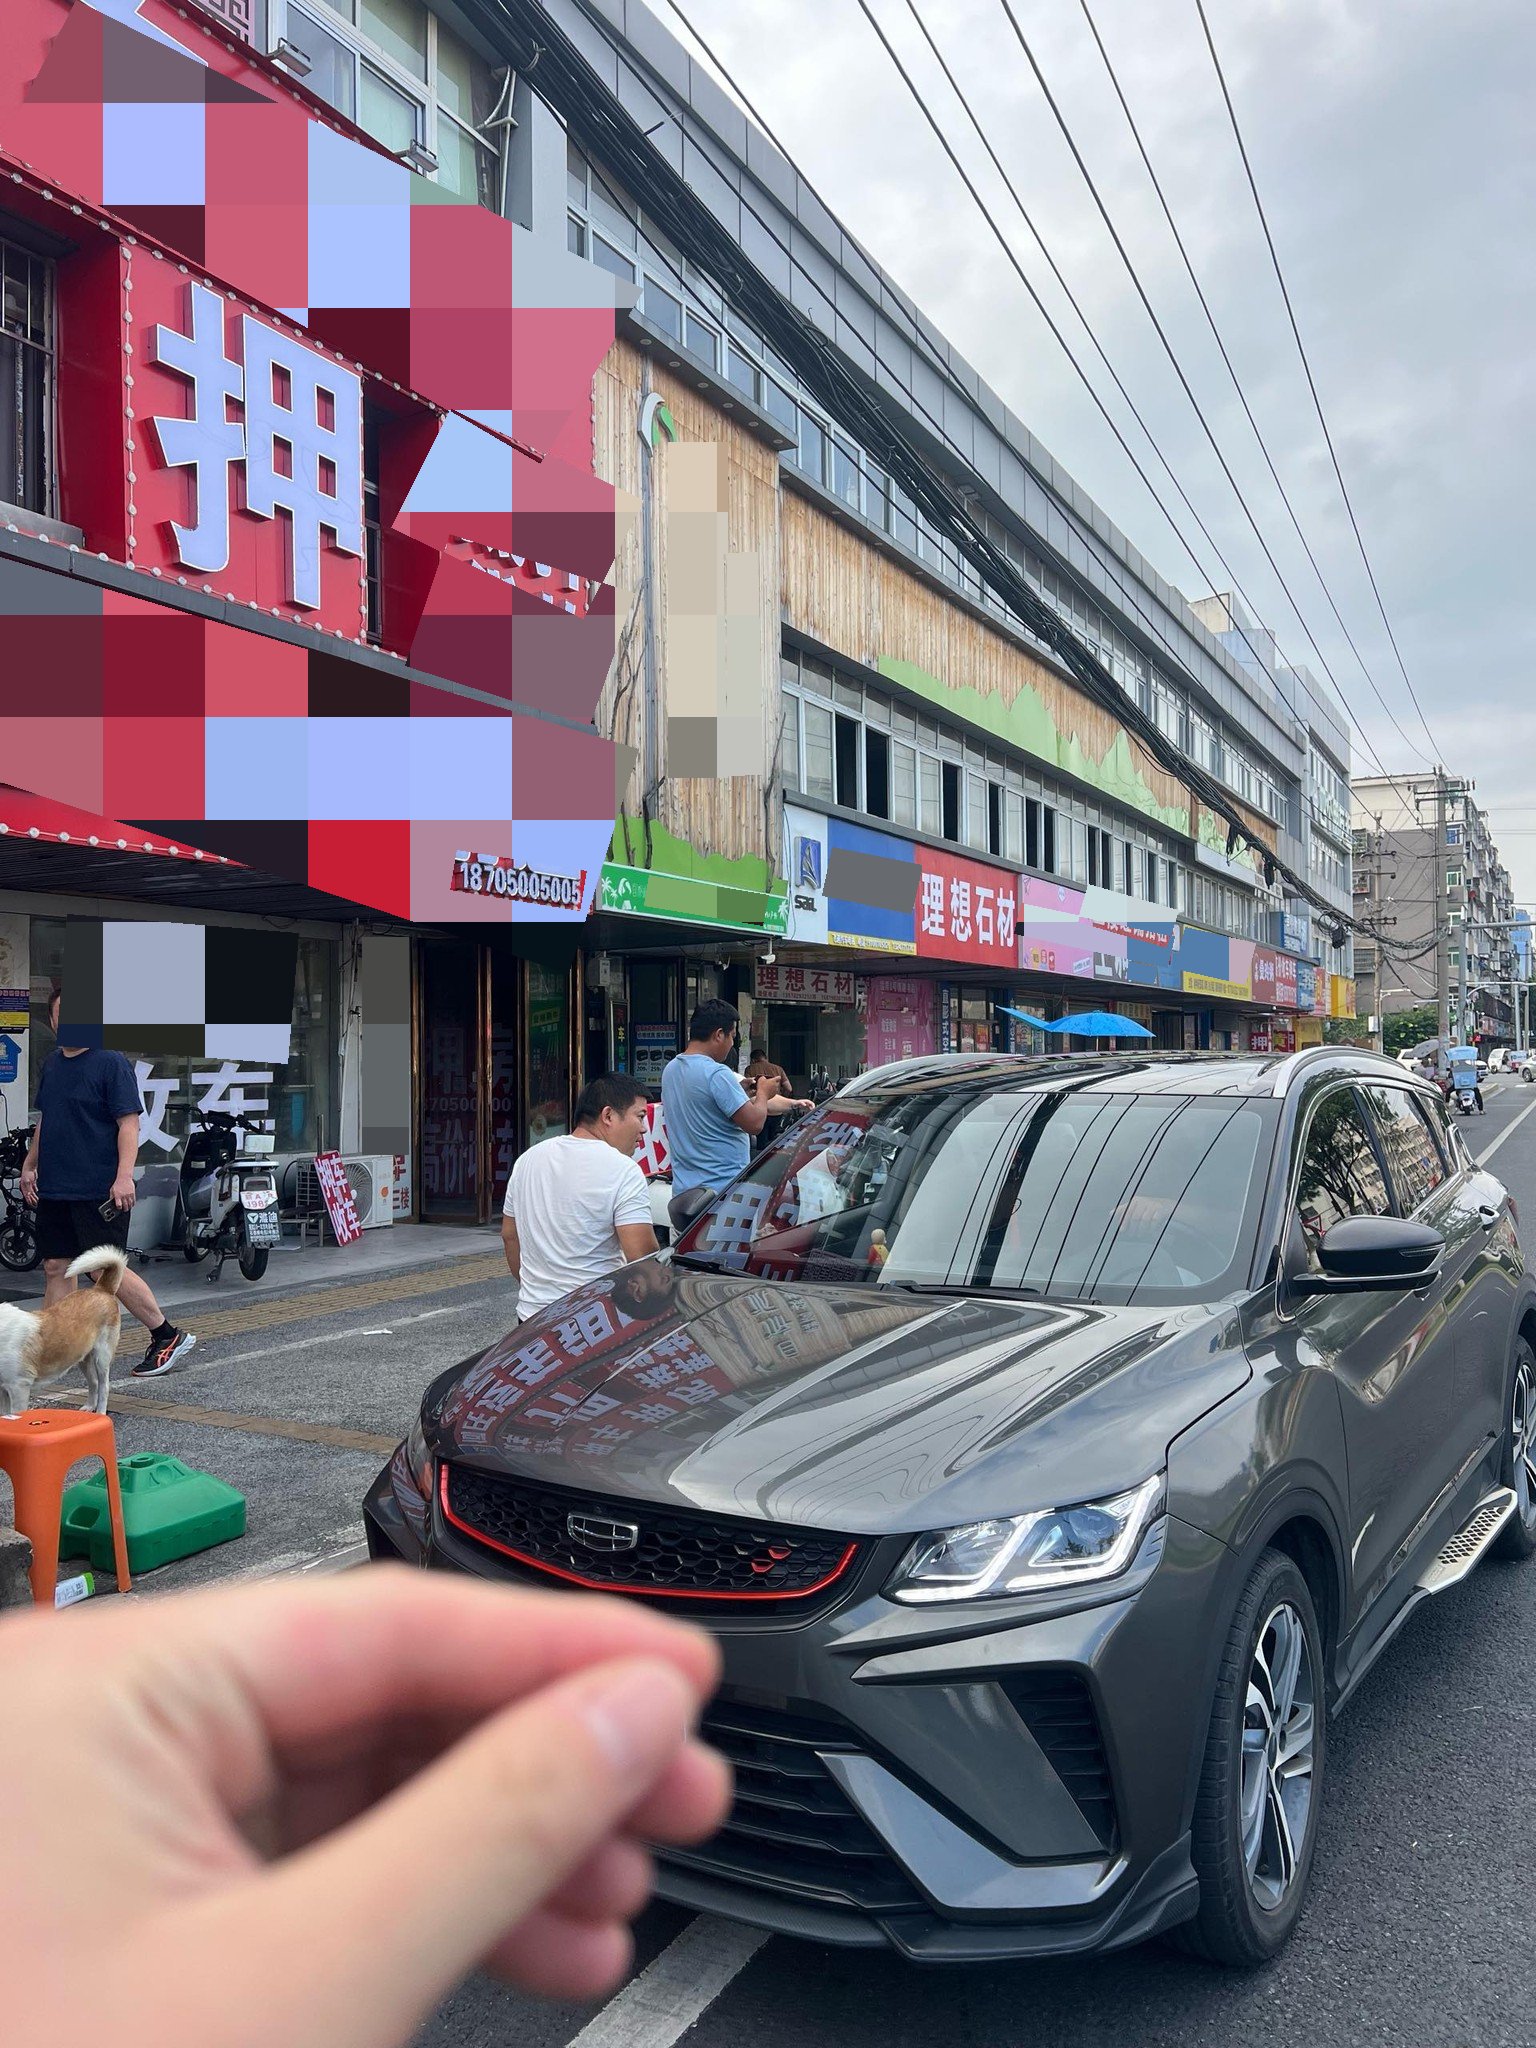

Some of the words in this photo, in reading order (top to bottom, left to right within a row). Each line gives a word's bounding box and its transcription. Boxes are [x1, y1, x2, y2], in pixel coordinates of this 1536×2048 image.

[150, 282, 364, 609] 押
[460, 861, 581, 905] 18705005005
[921, 873, 1016, 948] 理想石材
[757, 966, 853, 995] 理想石材
